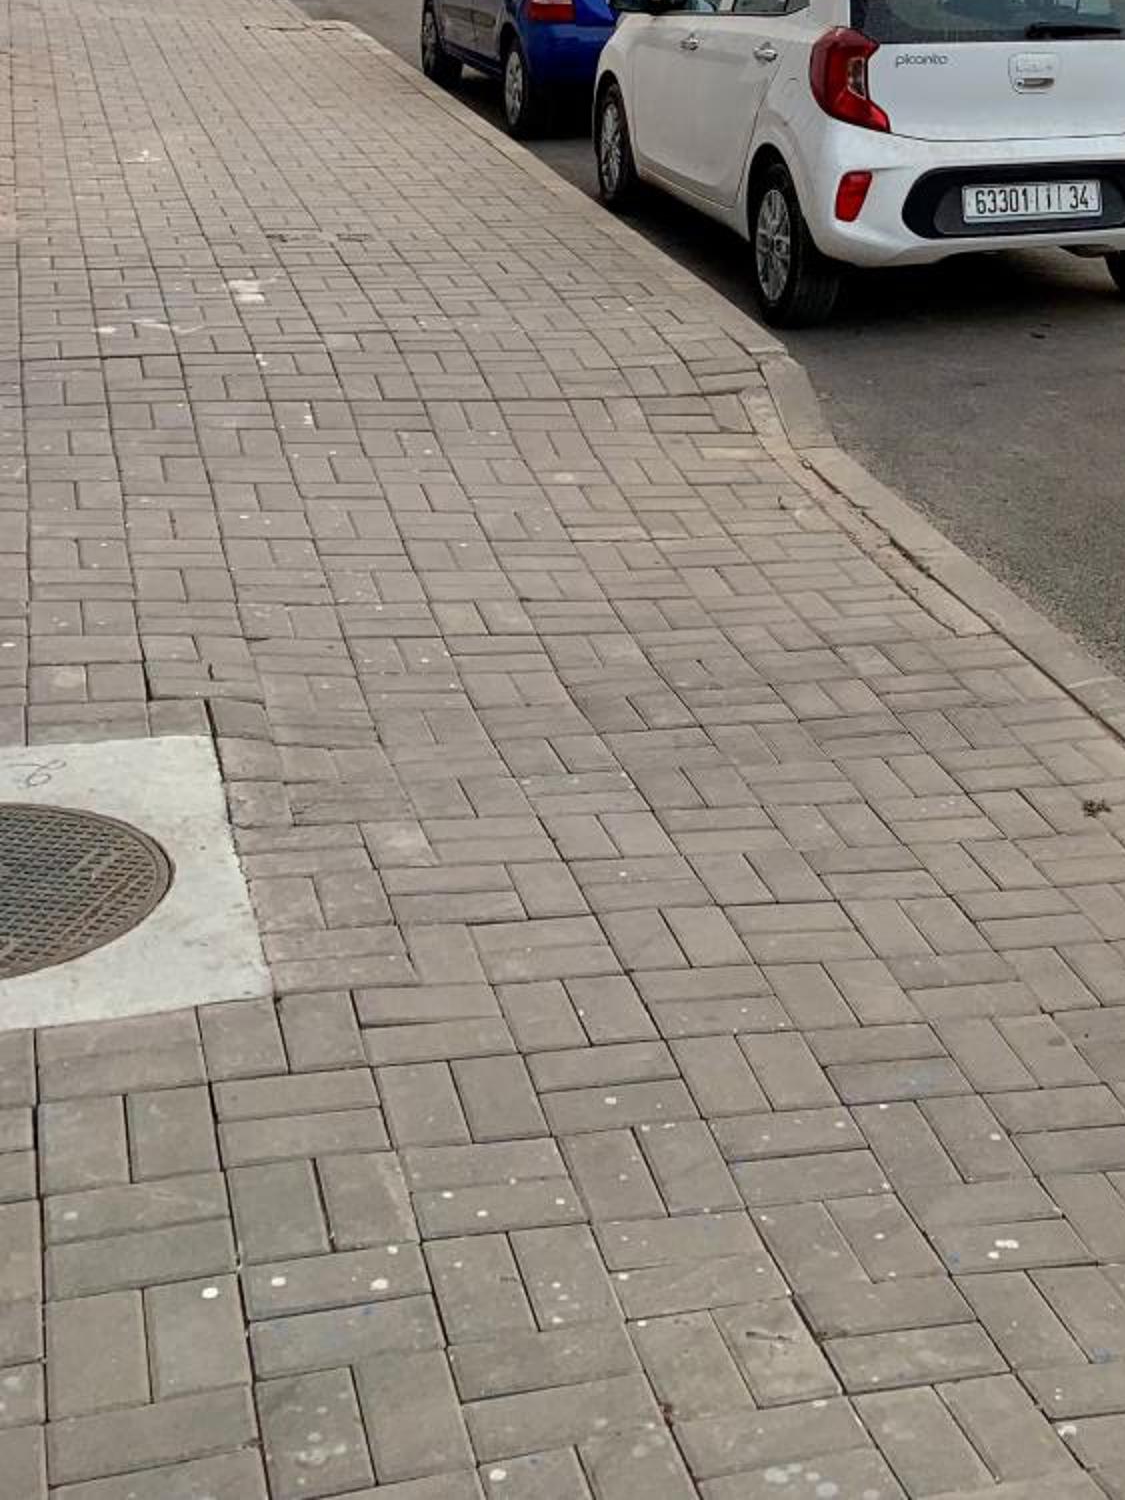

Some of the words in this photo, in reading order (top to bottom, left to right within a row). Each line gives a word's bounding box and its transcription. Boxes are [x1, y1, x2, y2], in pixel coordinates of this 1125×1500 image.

[895, 52, 948, 68] picanto
[975, 187, 1029, 214] 63301
[1069, 185, 1089, 209] 34
